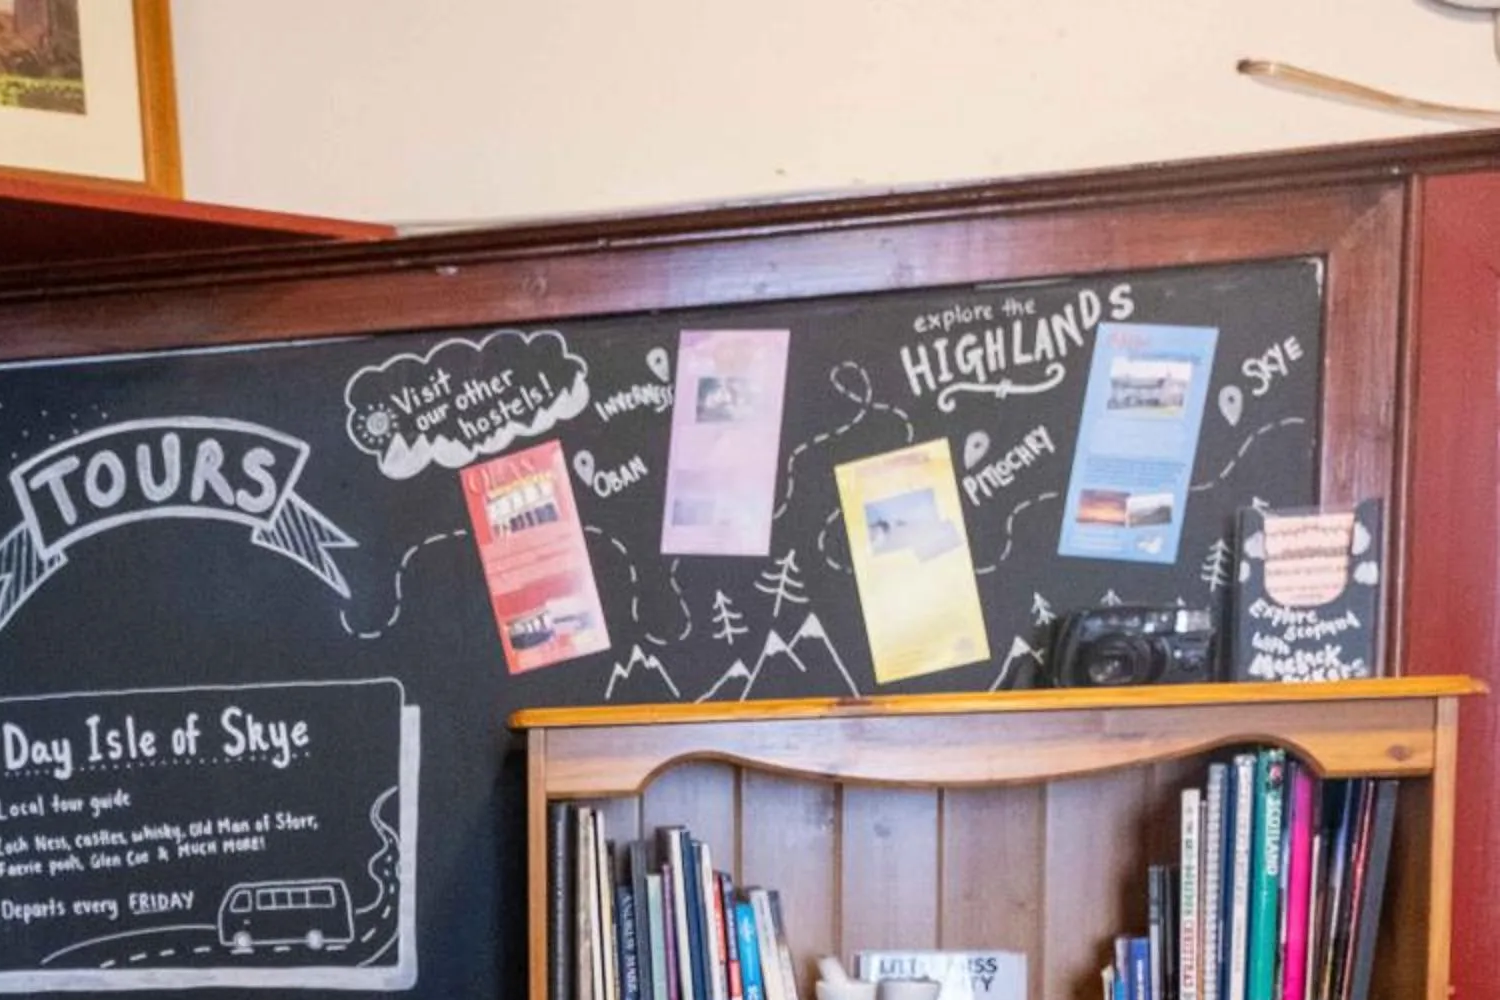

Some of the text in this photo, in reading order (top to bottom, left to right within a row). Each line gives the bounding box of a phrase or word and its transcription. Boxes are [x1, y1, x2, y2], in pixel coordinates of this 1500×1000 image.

[900, 284, 1134, 396] HIGHLANDS
[913, 297, 1036, 334] explore the
[390, 368, 451, 415] Visit
[1242, 336, 1304, 396] SKYE
[416, 367, 515, 432] our other
[458, 373, 555, 438] hostels!
[29, 432, 277, 525] TOURS
[593, 456, 648, 498] OBAN
[962, 425, 1055, 505] PITLOCHRY
[2, 722, 73, 779] Day
[86, 715, 153, 762] Isle
[171, 712, 202, 757] of
[221, 706, 310, 768] Skye
[52, 794, 83, 813] tour
[90, 789, 131, 818] guide
[189, 820, 213, 838] Old
[217, 818, 250, 833] Man
[256, 814, 270, 831] of
[90, 853, 121, 870] Glen
[126, 850, 149, 866] Coe
[157, 848, 169, 862] &
[178, 840, 218, 858] MUCH
[223, 836, 266, 854] MORE!
[1266, 792, 1284, 877] SCOTLAND
[1, 891, 194, 924] Departs every FRIDAY
